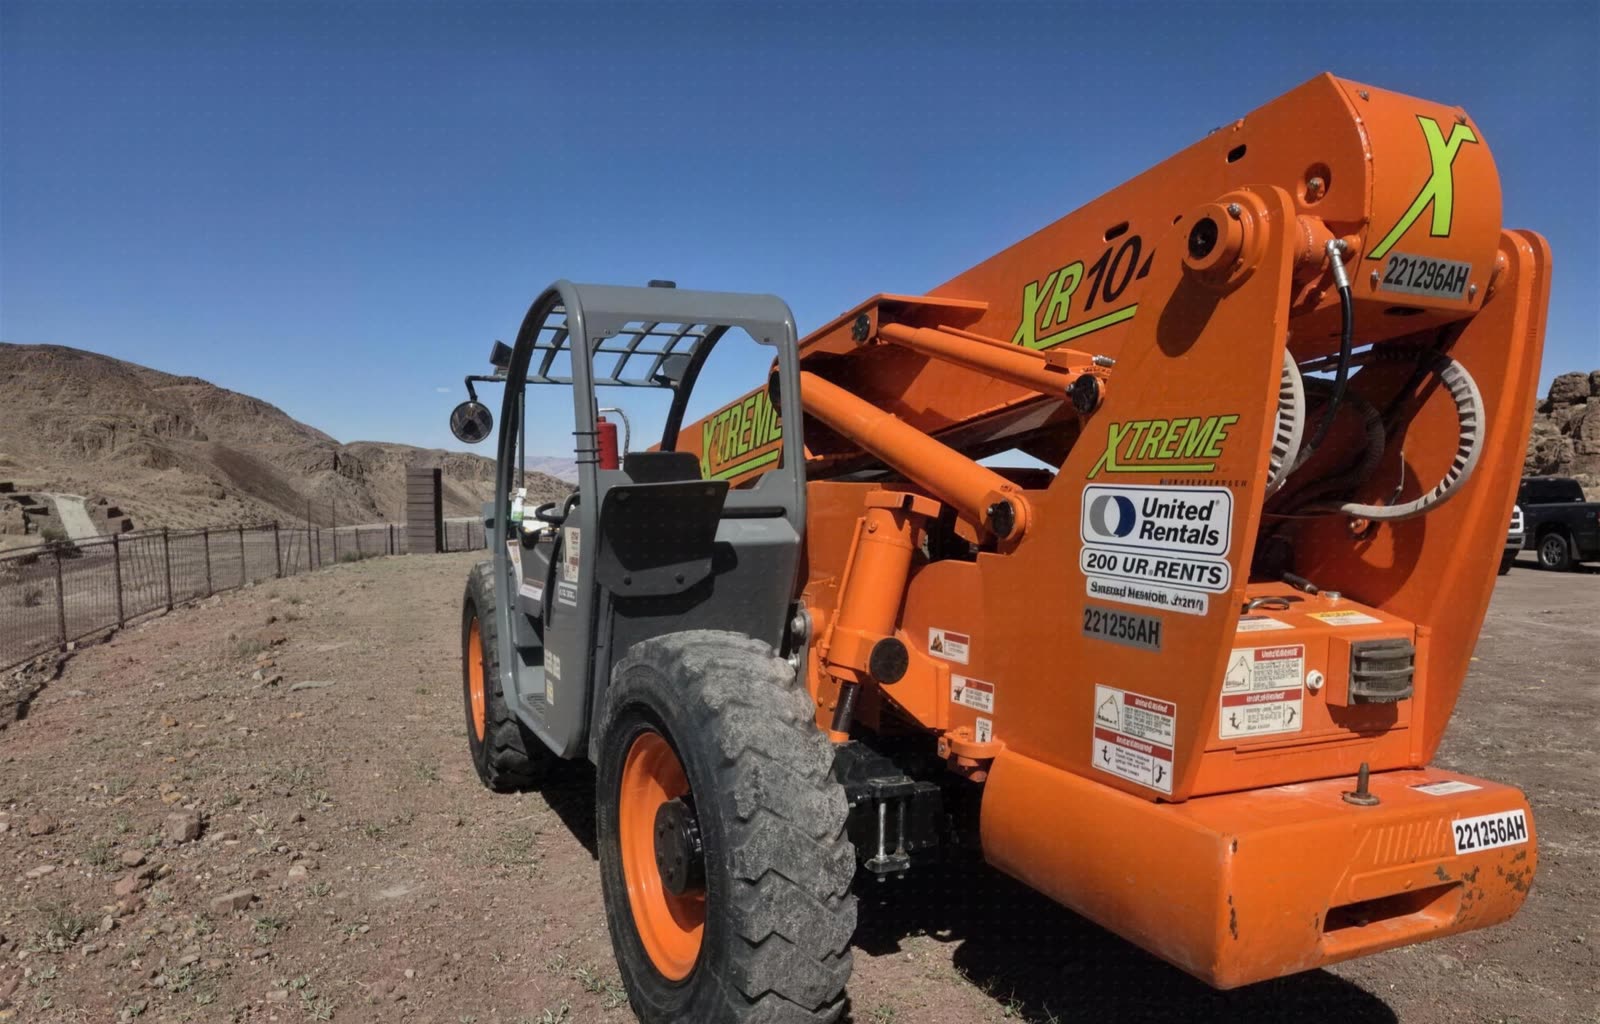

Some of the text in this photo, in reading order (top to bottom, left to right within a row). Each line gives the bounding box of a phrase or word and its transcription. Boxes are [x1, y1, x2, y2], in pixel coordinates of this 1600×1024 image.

[1365, 114, 1479, 260] X
[1382, 255, 1470, 294] 221296AH
[1086, 414, 1240, 480] XTREME
[1141, 496, 1215, 522] United
[1139, 521, 1220, 546] Rentals
[1455, 814, 1527, 851] 221256AH
